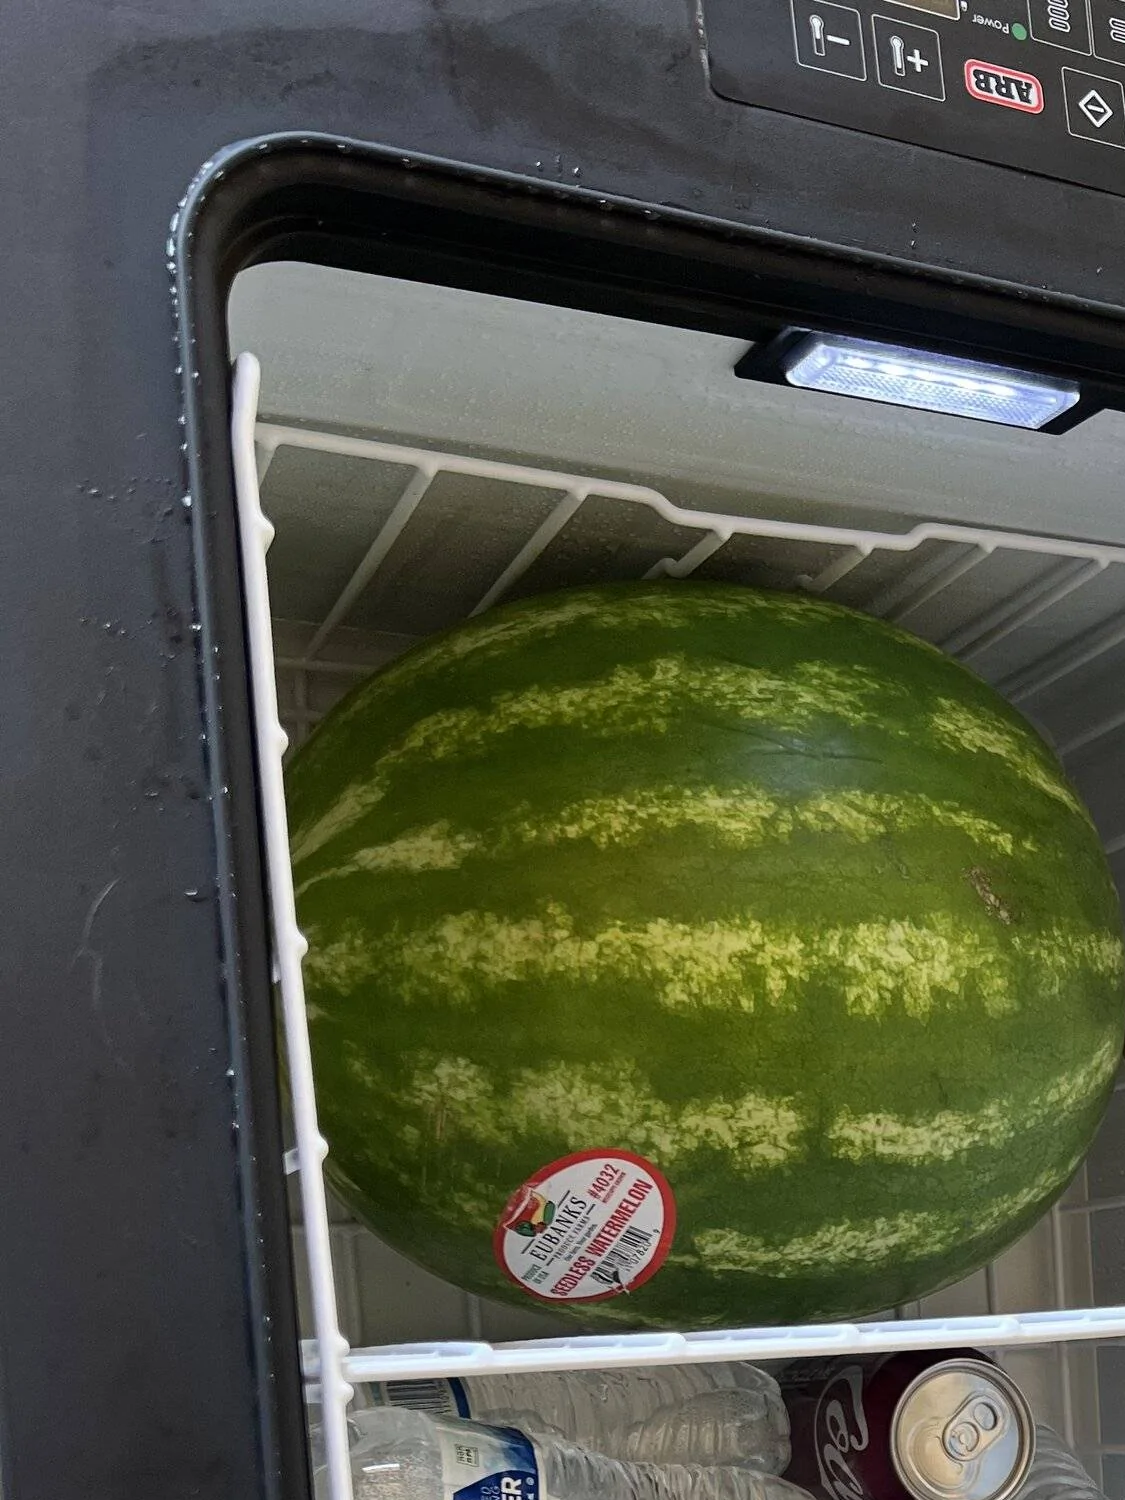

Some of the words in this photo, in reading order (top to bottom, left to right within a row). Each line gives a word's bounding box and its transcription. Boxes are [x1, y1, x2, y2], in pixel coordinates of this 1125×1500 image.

[972, 14, 1010, 34] Power
[973, 69, 1033, 105] ARB
[586, 1164, 620, 1200] #4032
[530, 1196, 587, 1262] EUBANKS
[551, 1255, 596, 1296] SEEDLESS
[585, 1179, 653, 1257] WATERMELON
